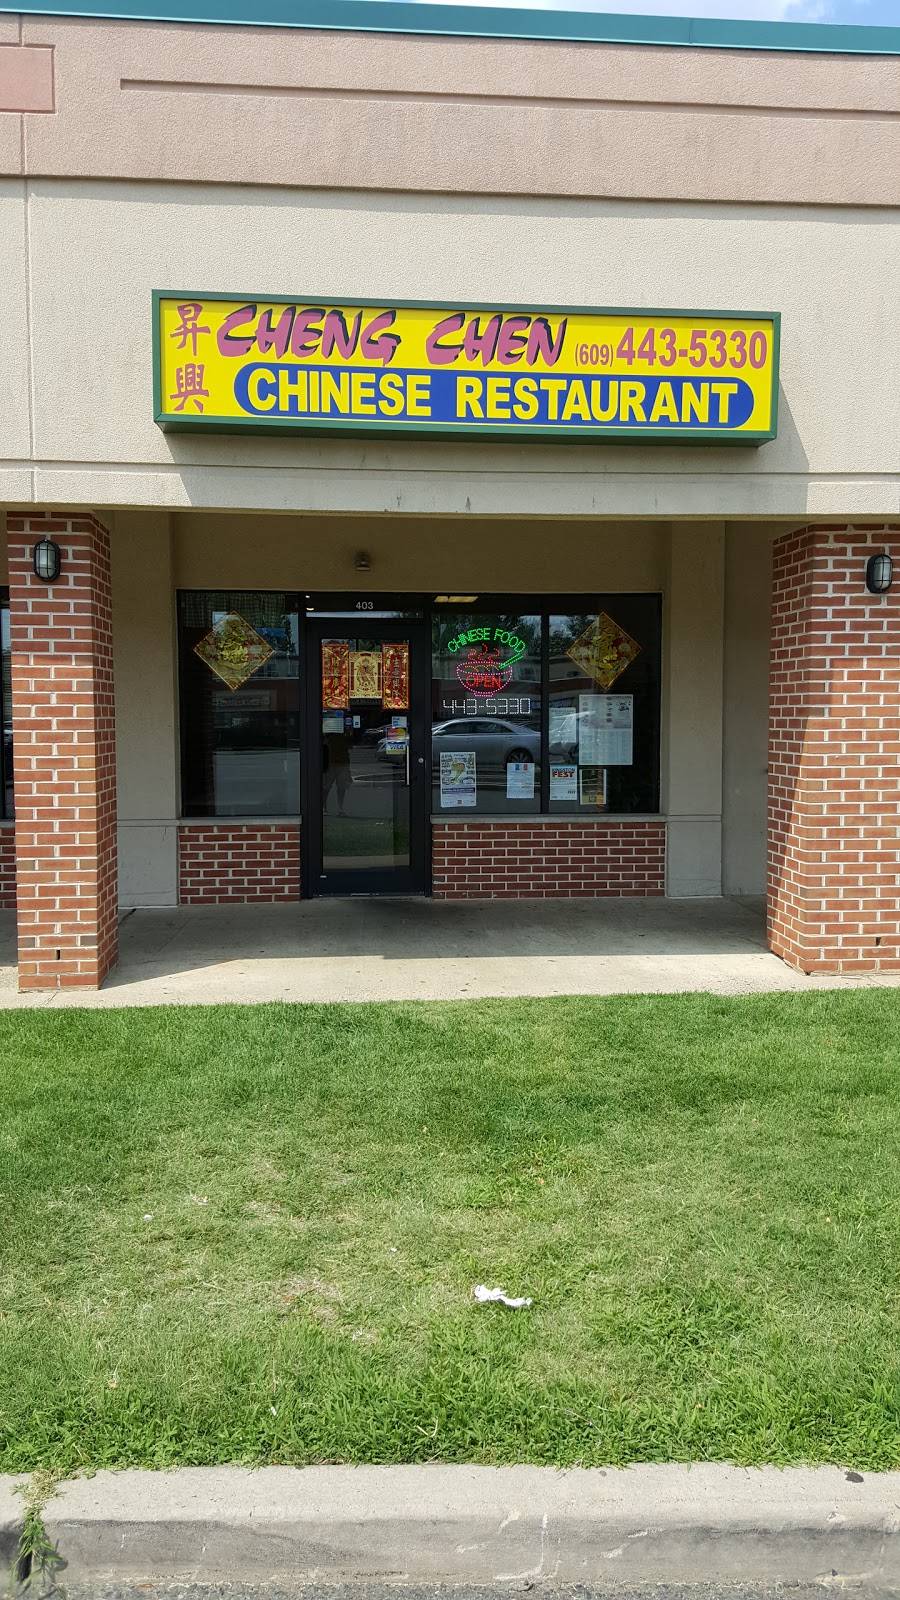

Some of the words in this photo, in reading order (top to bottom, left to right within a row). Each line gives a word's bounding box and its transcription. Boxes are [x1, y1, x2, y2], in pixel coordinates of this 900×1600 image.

[216, 303, 402, 366] CHENG
[425, 312, 568, 367] CHEN
[574, 343, 614, 368] (609)
[616, 327, 767, 369] 443-5330
[247, 368, 432, 417] CHINESE
[455, 375, 738, 424] RESTAURANT
[356, 601, 374, 610] 403
[447, 627, 491, 652] CHINESE
[493, 628, 526, 653] FOOD
[466, 674, 503, 689] OPEN
[442, 698, 531, 715] 443-5330
